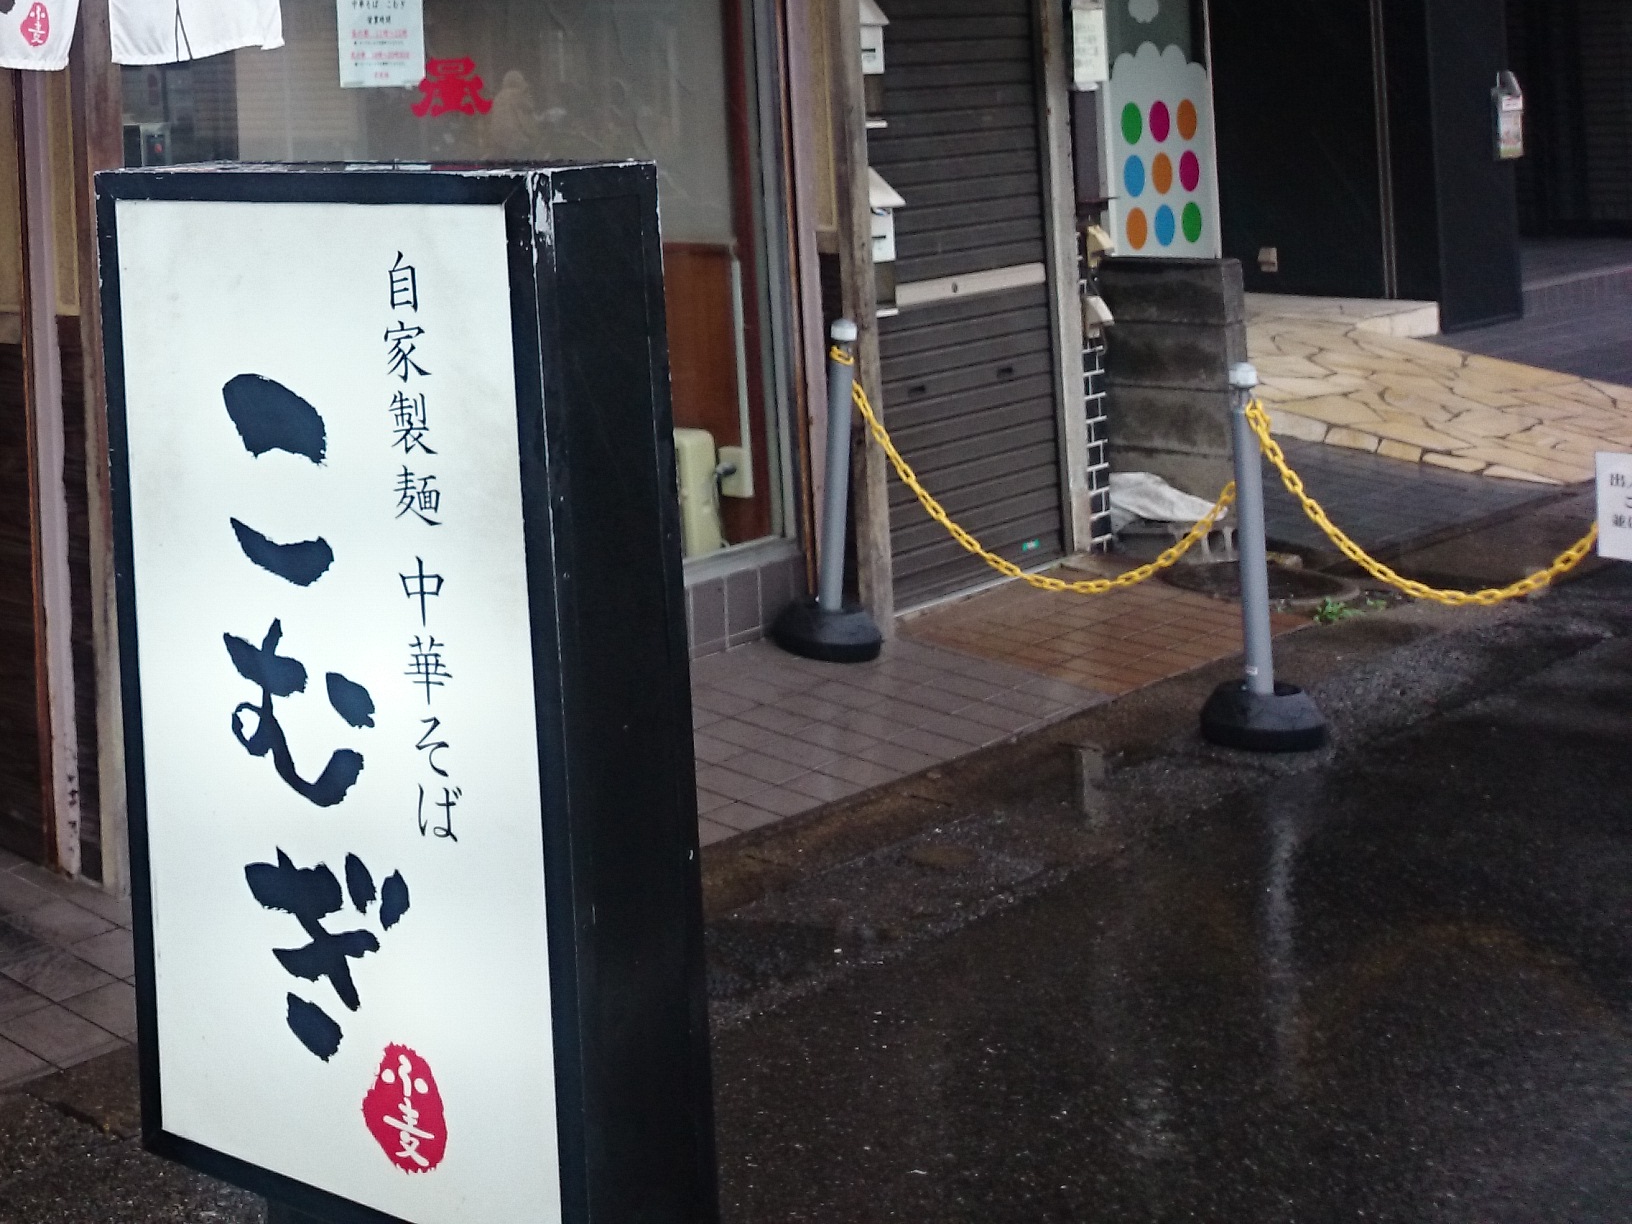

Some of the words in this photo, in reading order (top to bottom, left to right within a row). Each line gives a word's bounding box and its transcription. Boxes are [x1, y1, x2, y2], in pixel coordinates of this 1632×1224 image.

[382, 249, 442, 527] 自家製麺
[223, 372, 411, 1062] こむぎ
[398, 555, 459, 843] 中華そば
